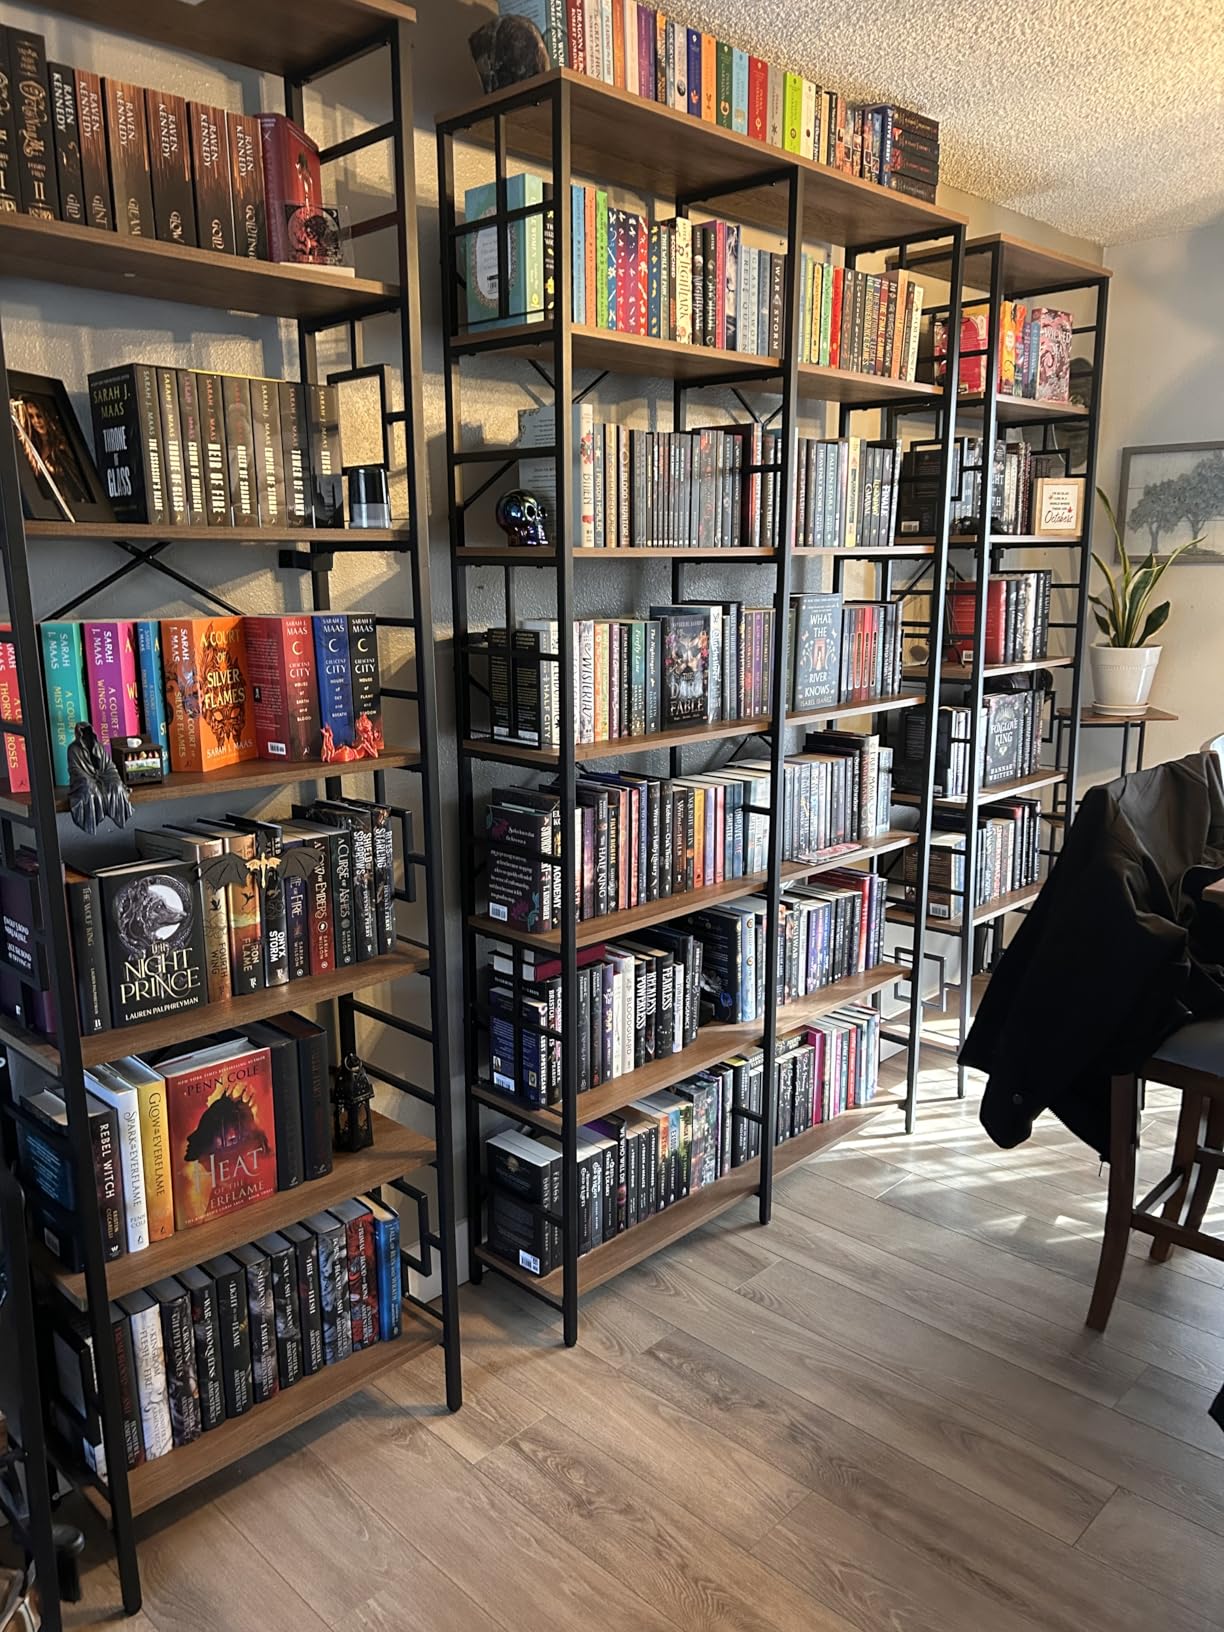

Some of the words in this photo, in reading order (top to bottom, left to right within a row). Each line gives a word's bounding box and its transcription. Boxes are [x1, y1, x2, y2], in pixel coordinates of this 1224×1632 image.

[53, 72, 66, 133] KENNEDY
[64, 84, 74, 124] RAVEN
[80, 81, 92, 139] KENNEDY
[90, 93, 100, 132] RAVEN
[116, 90, 128, 147] KENNEDY
[126, 102, 135, 140] RAVEN
[159, 104, 170, 159] KENNEDY
[167, 114, 178, 152] RAVEN
[201, 114, 211, 168] KENNEDY
[209, 124, 218, 162] RAVEN
[236, 126, 247, 177] KENNEDY
[244, 136, 254, 172] RAVEN
[92, 195, 108, 229] GLINT
[128, 198, 141, 235] GLEAM
[170, 211, 184, 243] GLOW
[212, 219, 224, 249] GOLD
[94, 388, 120, 401] SARAH
[124, 384, 130, 400] J.
[164, 374, 172, 401] SARAH
[101, 402, 124, 418] MAAS
[147, 412, 155, 435] MAAS
[103, 426, 127, 451] THRONE
[167, 414, 175, 437] MAAS
[148, 439, 157, 451] THE
[168, 440, 181, 471] THRONE
[208, 444, 222, 468] HEIR
[107, 466, 132, 497] GLASS
[171, 474, 181, 484] OF
[210, 473, 223, 486] OF
[294, 480, 303, 490] OF
[172, 487, 184, 512] GLASS
[212, 490, 226, 514] FIRE
[287, 626, 308, 635] MAAS
[323, 624, 344, 633] MAAS
[352, 624, 373, 633] MAAS
[810, 613, 832, 625] WHAT
[814, 627, 827, 637] THE
[60, 633, 70, 667] SARAH
[94, 637, 103, 666] MAAS
[104, 631, 114, 663] SARAH
[171, 636, 180, 662] MAAS
[180, 629, 190, 660] SARAH
[210, 629, 240, 645] COURT
[50, 640, 59, 670] MAAS
[217, 652, 226, 662] OF
[326, 664, 346, 674] CITY
[354, 664, 375, 674] CITY
[207, 669, 240, 688] SILVER
[289, 668, 310, 678] CITY
[809, 672, 827, 683] RIVER
[54, 686, 63, 709] MIST
[97, 679, 106, 710] WINGS
[108, 686, 116, 694] A
[204, 688, 245, 709] FLAMES
[804, 686, 829, 698] KNOWS
[109, 697, 118, 730] COURT
[175, 691, 184, 721] SILVER
[670, 701, 704, 716] FABLE
[57, 722, 66, 747] FURY
[177, 724, 186, 757] FLAMES
[188, 720, 196, 747] COURT
[992, 718, 1017, 734] FOXGLOVE
[995, 732, 1013, 747] KING
[7, 732, 18, 769] ROSES
[207, 746, 225, 759] SARAH
[989, 770, 1014, 780] WHITTEN
[990, 764, 1013, 774] HANNAH
[337, 845, 349, 879] CURSE
[354, 831, 365, 875] SPARROWS
[363, 832, 372, 862] SHIELD
[375, 828, 386, 868] STARLING
[553, 865, 561, 908] ACADEMY
[598, 872, 606, 897] KING
[315, 882, 327, 919] EMBERS
[340, 888, 350, 918] ASHES
[218, 942, 228, 979] FOURTH
[242, 938, 253, 972] FLAME
[251, 942, 259, 964] IRON
[270, 930, 279, 963] STORM
[125, 948, 193, 982] NIGHT
[120, 967, 200, 1004] PRINCE
[647, 972, 656, 1015] RECKLESS
[662, 967, 672, 1010] FEARLESS
[125, 1007, 152, 1021] LAUREN
[153, 997, 199, 1015] PALPHREYMAN
[636, 975, 646, 1029] POWERLESS
[187, 1077, 224, 1096] PENN
[227, 1065, 259, 1084] COLE
[149, 1092, 161, 1129] GLOW
[100, 1123, 111, 1158] REBEL
[123, 1112, 137, 1144] SPARK
[130, 1150, 141, 1207] EVERFLAME
[153, 1135, 165, 1196] EVERFLAME
[194, 1146, 264, 1194] HEAT
[103, 1160, 115, 1199] WITCH
